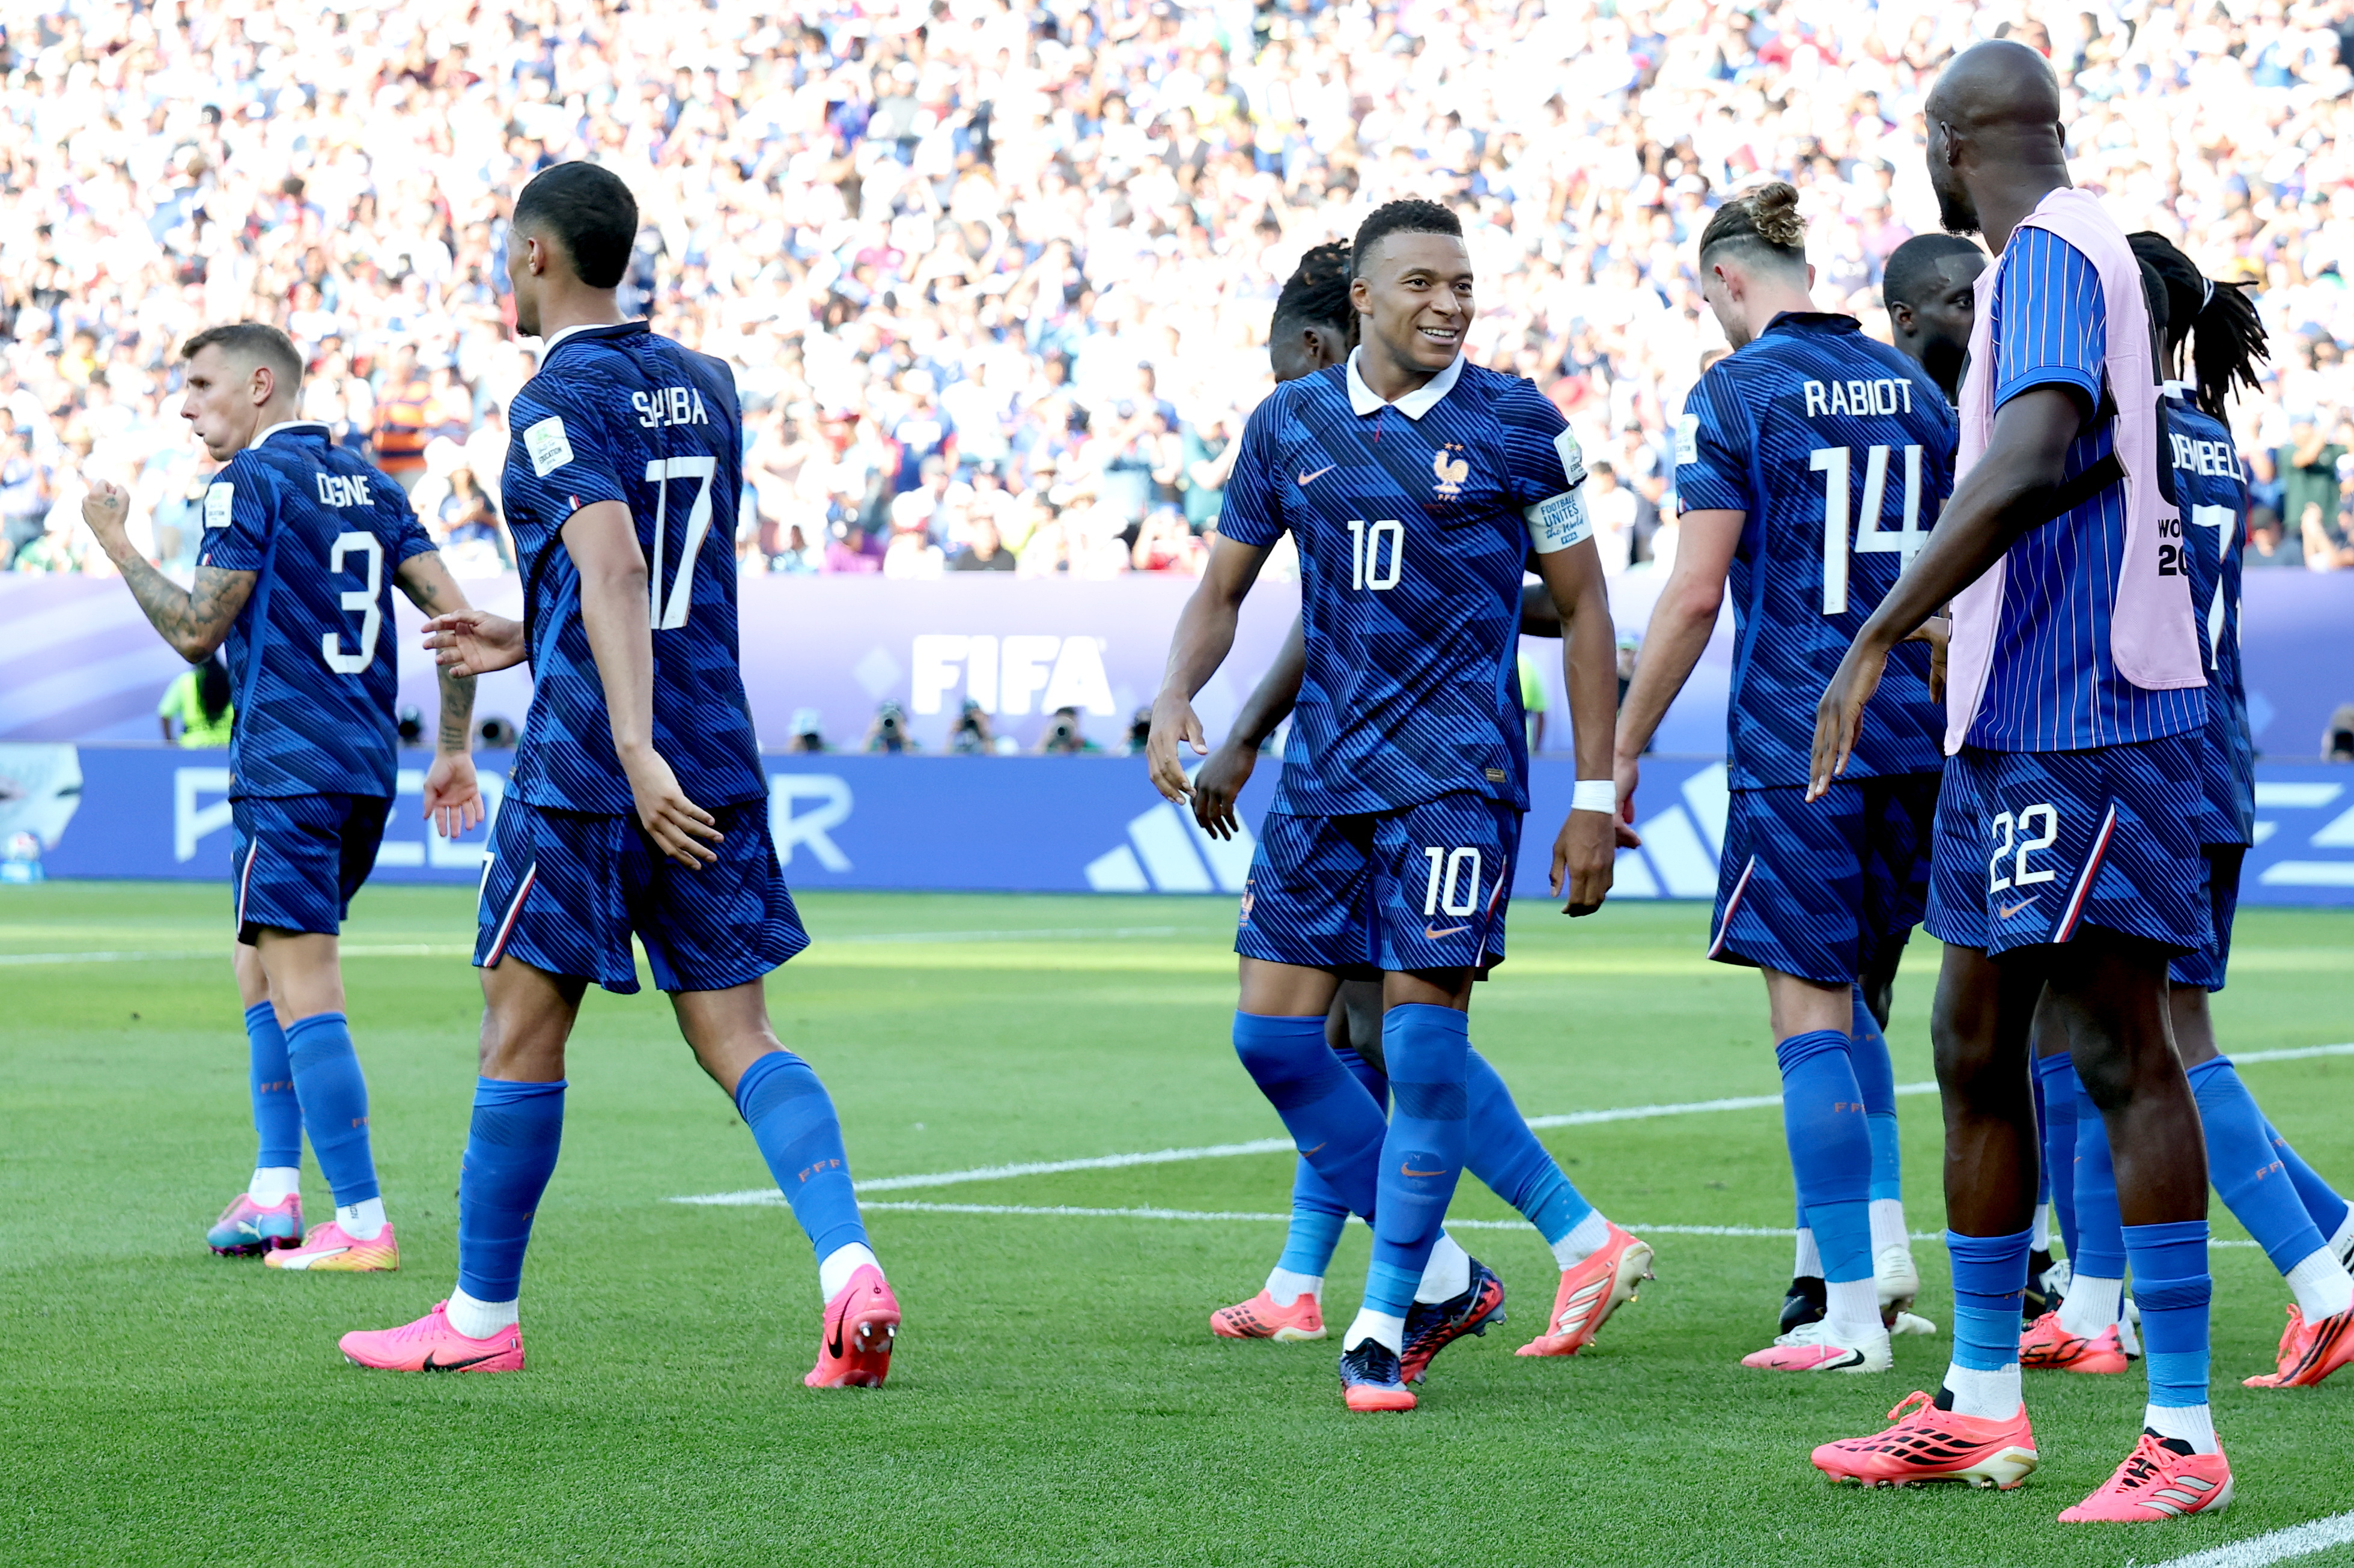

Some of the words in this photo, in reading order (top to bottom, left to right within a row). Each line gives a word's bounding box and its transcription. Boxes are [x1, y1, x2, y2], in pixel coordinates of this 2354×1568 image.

[1804, 378, 1912, 418] RABIOT
[1540, 494, 1576, 515] FOOTBALL
[1543, 503, 1579, 527] UNITES
[1544, 527, 1562, 539] the
[1563, 514, 1584, 533] World
[1809, 445, 1930, 615] 14
[645, 456, 718, 630] 17
[1348, 520, 1404, 591] 10
[322, 531, 383, 674] 3
[2192, 503, 2237, 670] 7
[911, 634, 1116, 716] FIFA
[1424, 846, 1481, 917] 10
[1989, 803, 2058, 894] 22
[798, 1158, 841, 1183] FFF
